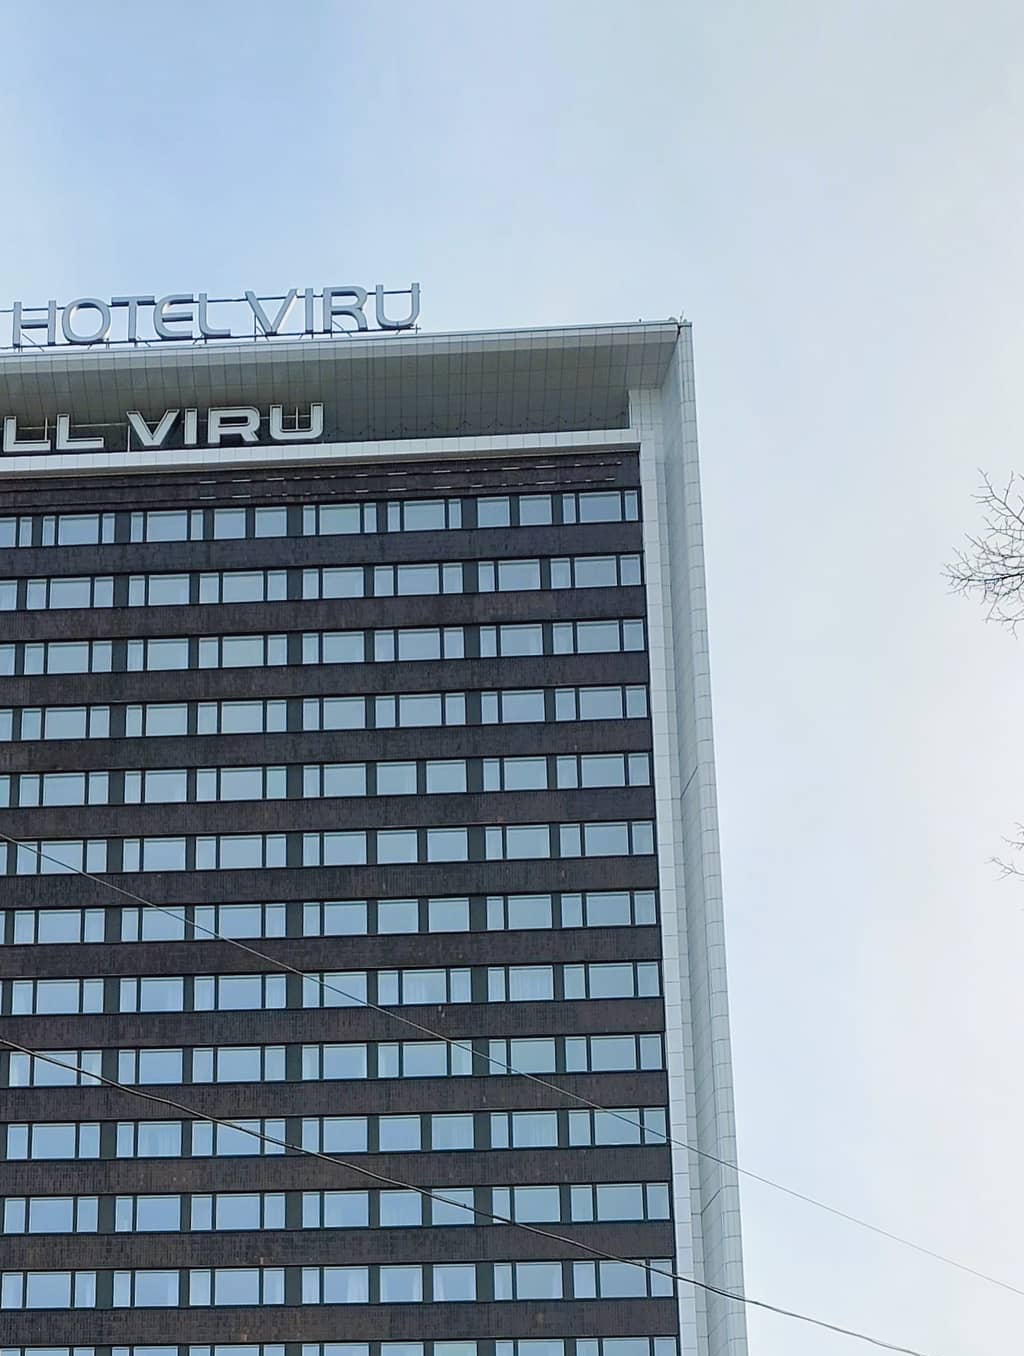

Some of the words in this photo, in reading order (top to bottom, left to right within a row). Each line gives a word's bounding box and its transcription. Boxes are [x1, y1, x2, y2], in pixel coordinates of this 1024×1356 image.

[13, 293, 231, 347] HOTEL
[244, 282, 420, 336] VIRU
[126, 403, 324, 446] VIRU
